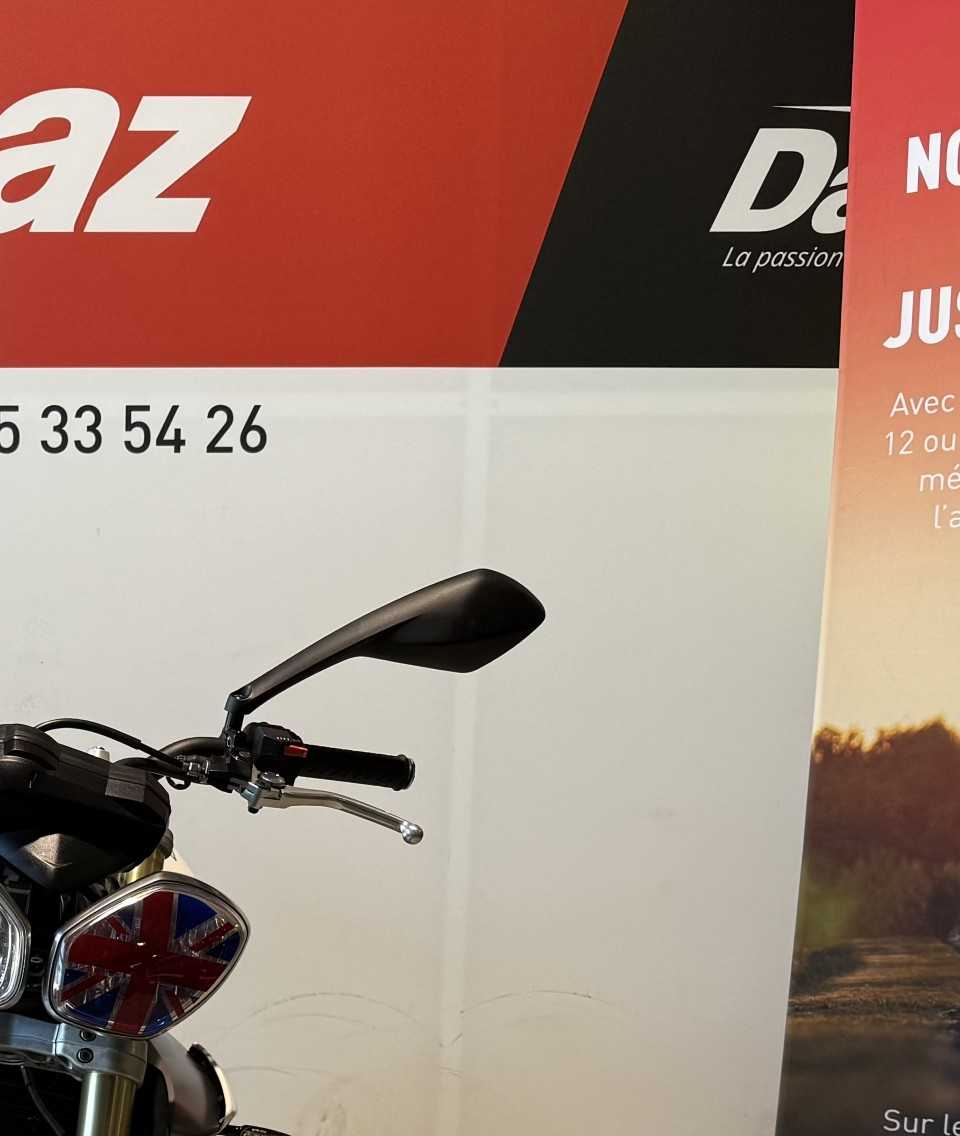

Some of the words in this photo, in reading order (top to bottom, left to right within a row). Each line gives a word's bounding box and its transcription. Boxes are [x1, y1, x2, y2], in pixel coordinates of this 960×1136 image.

[722, 246, 752, 267] La
[751, 246, 844, 273] passion
[882, 285, 960, 349] JU
[890, 391, 956, 417] Avec
[40, 404, 103, 454] 33
[123, 404, 186, 454] 54
[206, 404, 267, 454] 26
[885, 430, 914, 456] 12
[924, 432, 957, 453] ou
[919, 463, 960, 492] mé
[883, 1109, 935, 1134] Sur
